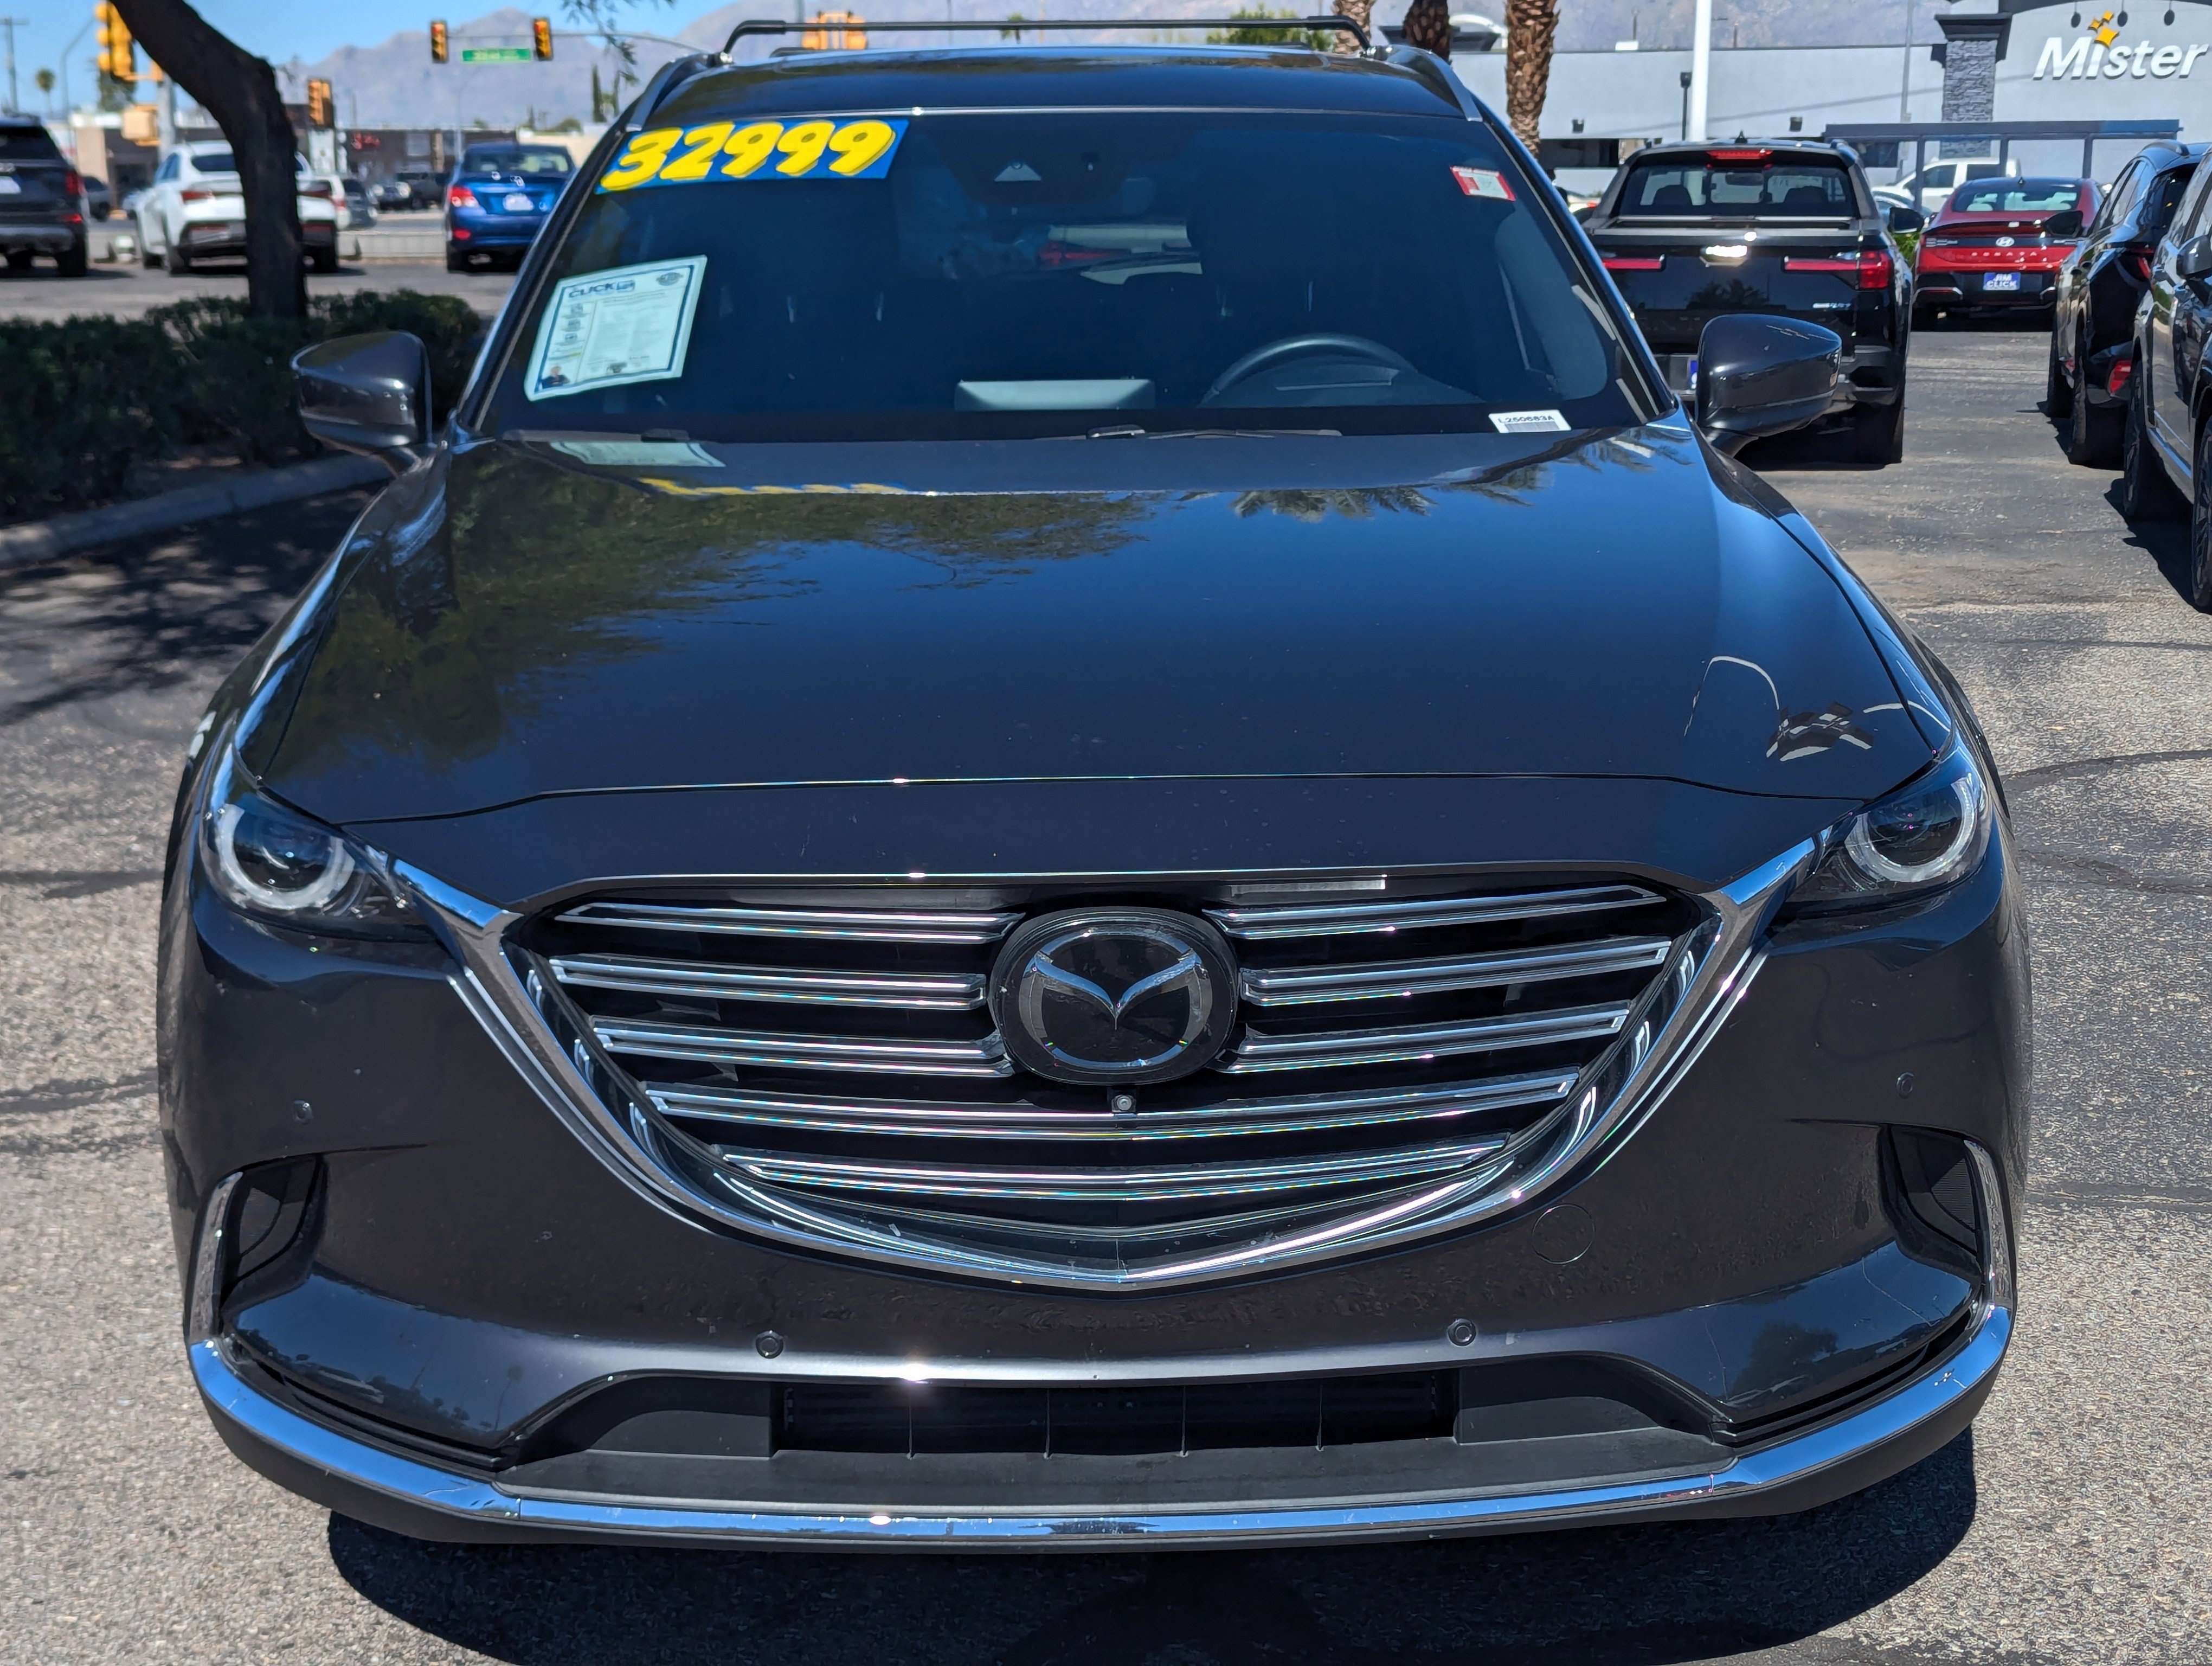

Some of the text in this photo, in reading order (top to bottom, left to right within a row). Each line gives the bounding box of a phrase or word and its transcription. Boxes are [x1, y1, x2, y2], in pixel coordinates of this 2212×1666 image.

[2033, 36, 2209, 80] Mister
[601, 120, 896, 190] 32999
[569, 283, 615, 298] CLICK
